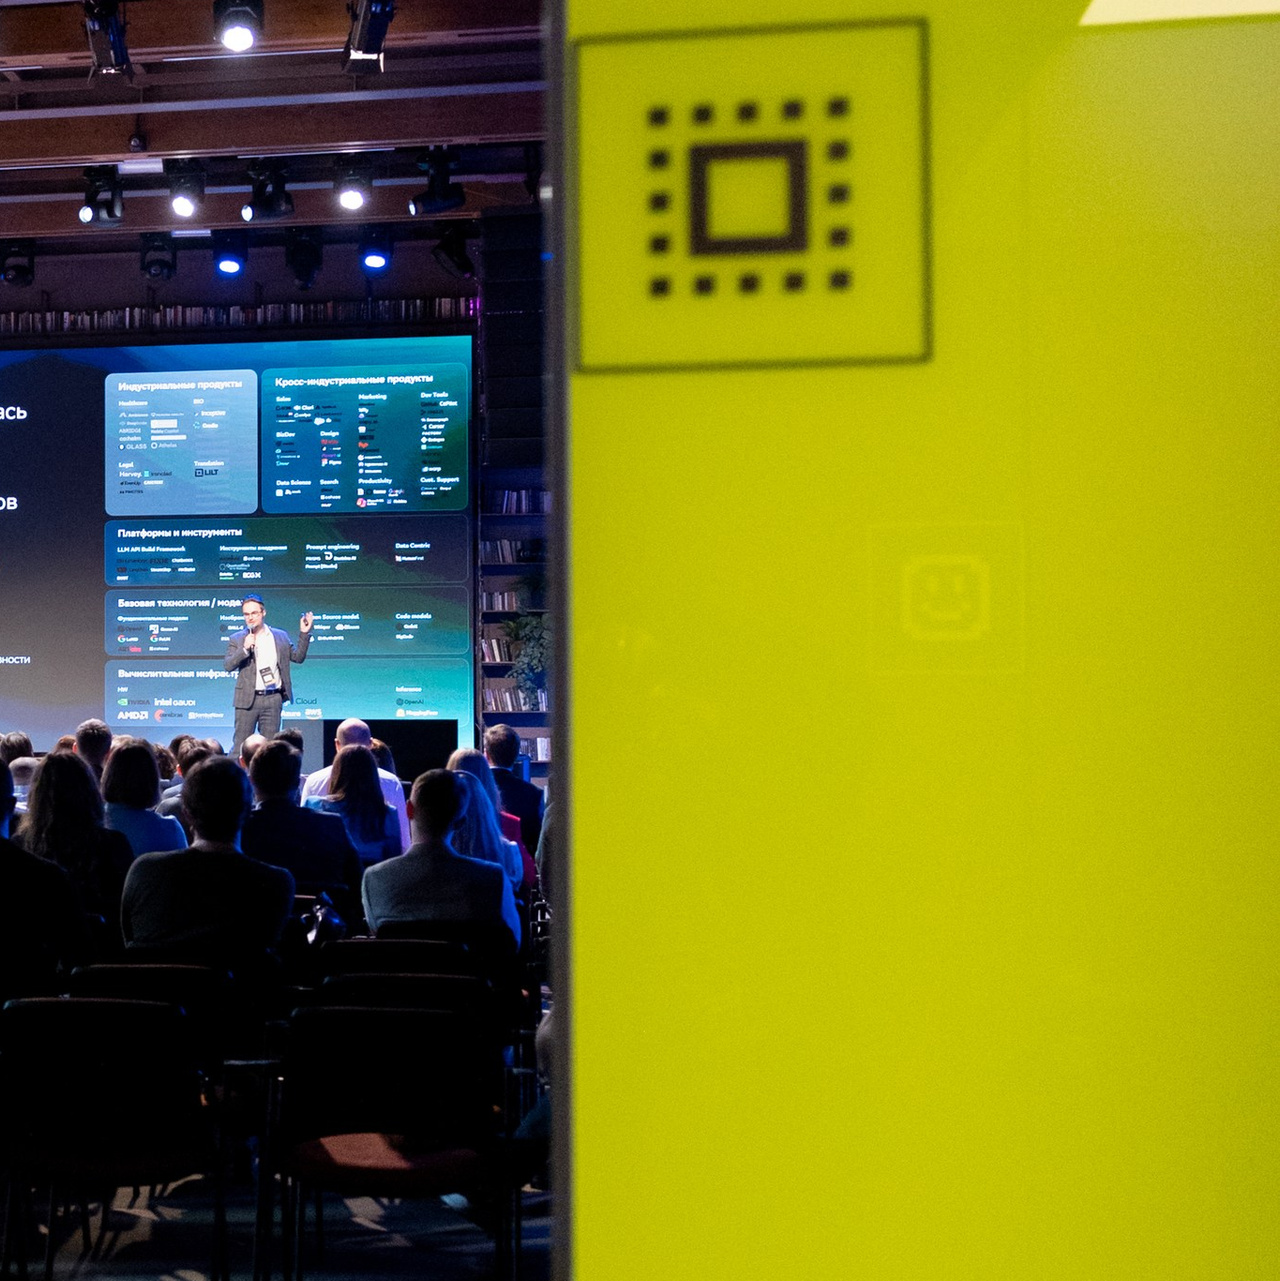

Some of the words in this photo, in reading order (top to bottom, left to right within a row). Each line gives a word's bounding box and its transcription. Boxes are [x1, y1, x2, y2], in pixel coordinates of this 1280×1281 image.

[118, 381, 196, 392] Индустриальные
[197, 380, 243, 391] продукты
[275, 377, 386, 388] Кросс-индустриальные
[387, 375, 434, 385] продукты
[117, 528, 172, 539] Платформы
[181, 528, 243, 539] инструменты
[118, 598, 156, 608] Базовая
[157, 599, 210, 608] технология
[118, 669, 195, 679] Вычислительная
[295, 697, 317, 705] Cloud
